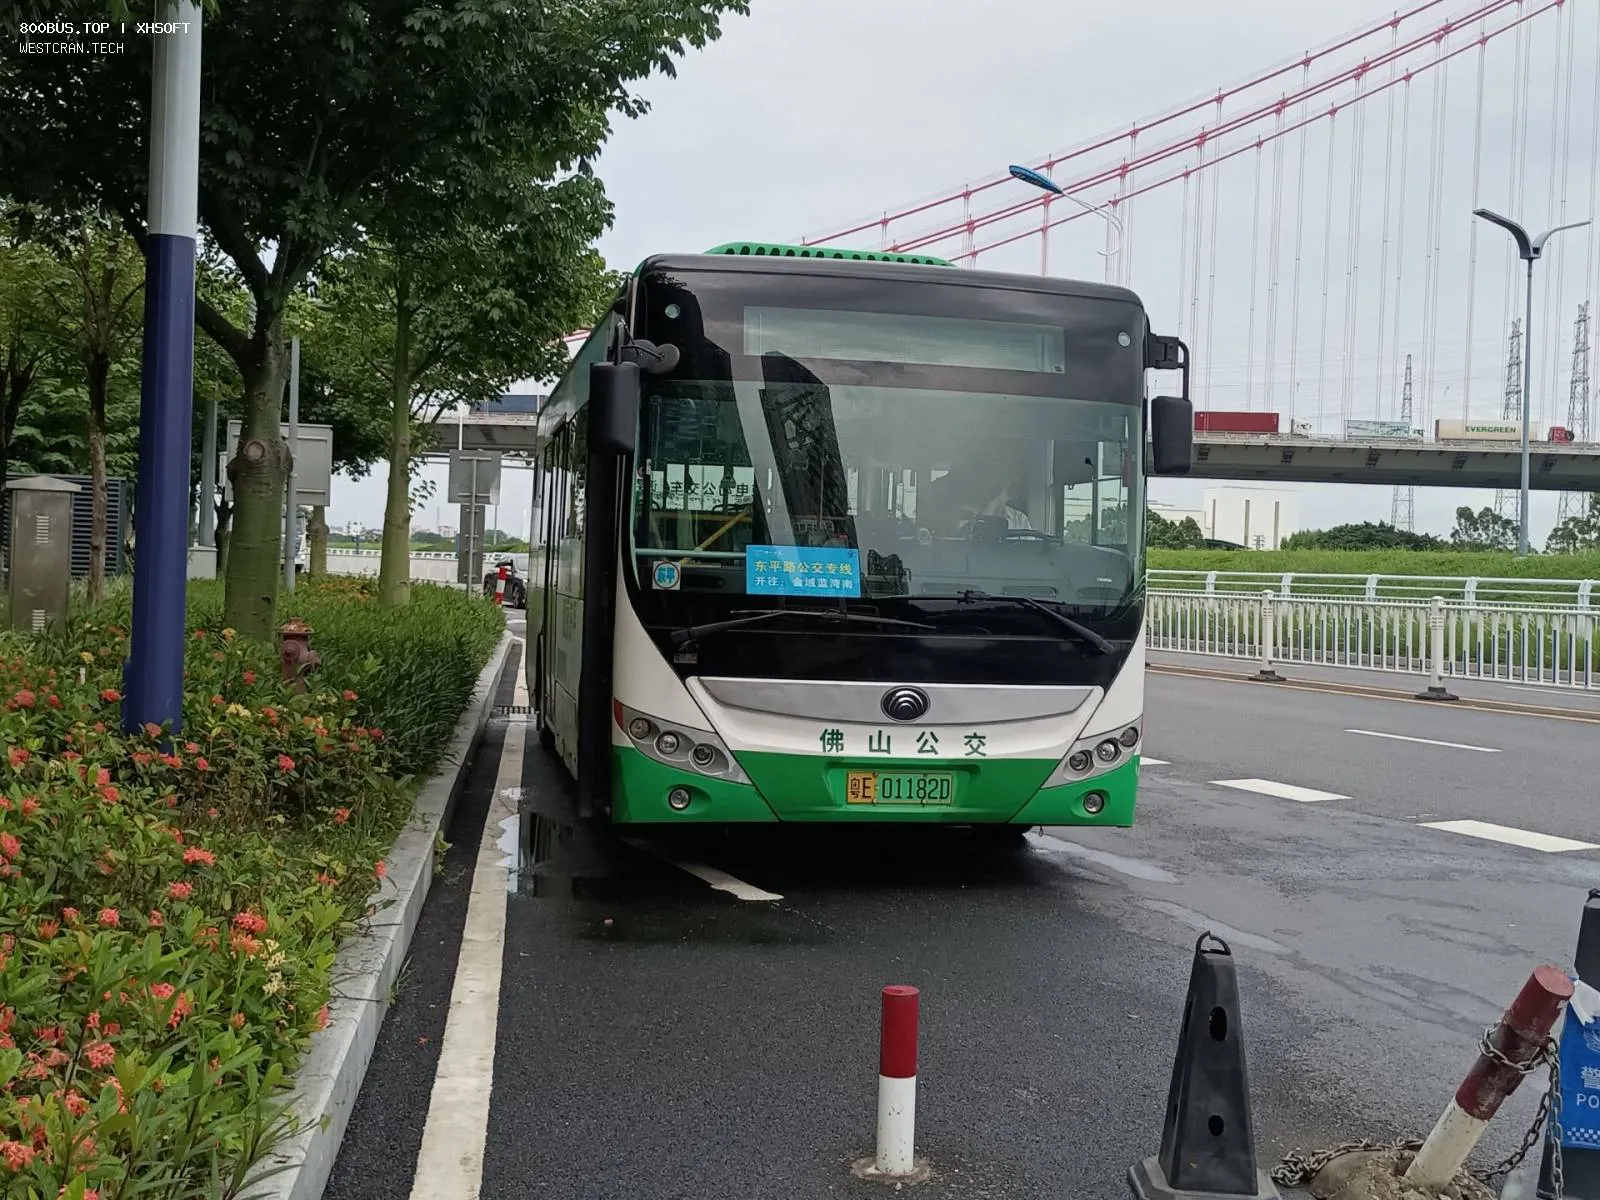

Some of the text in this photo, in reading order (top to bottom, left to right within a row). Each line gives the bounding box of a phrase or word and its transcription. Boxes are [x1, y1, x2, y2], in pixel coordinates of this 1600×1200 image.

[754, 559, 853, 576] 东平路公交专线
[819, 728, 987, 757] 佛山公交
